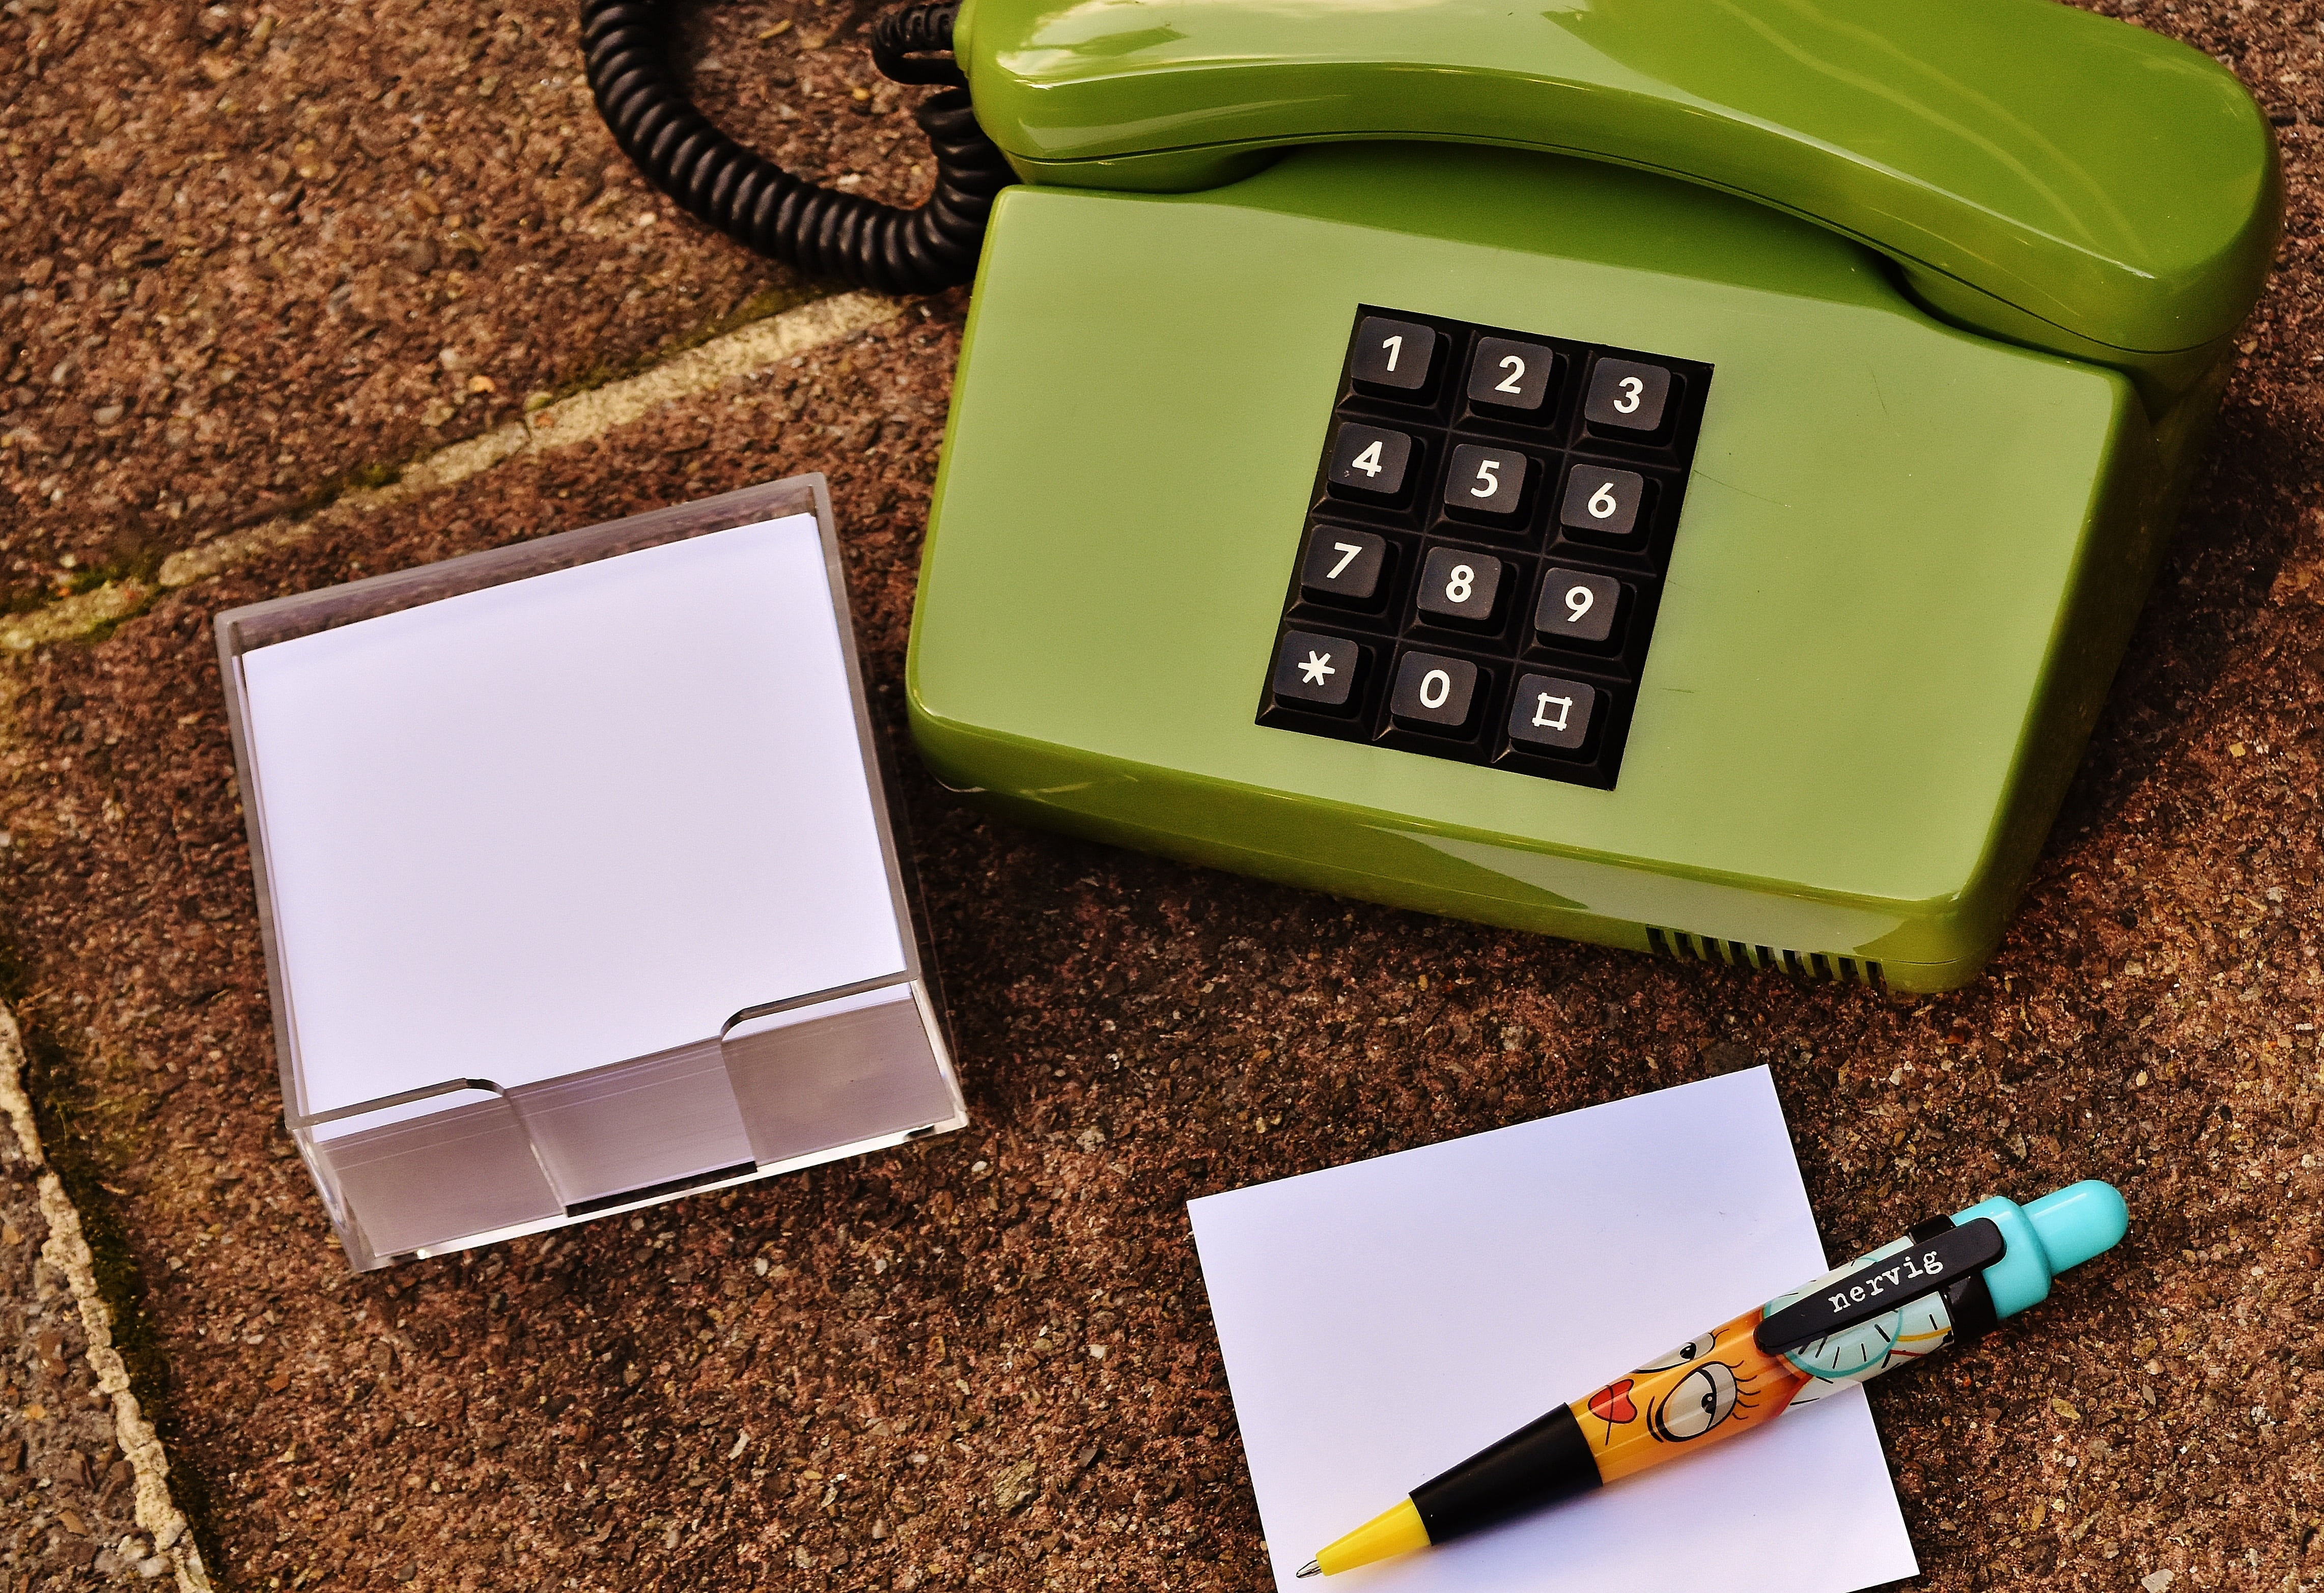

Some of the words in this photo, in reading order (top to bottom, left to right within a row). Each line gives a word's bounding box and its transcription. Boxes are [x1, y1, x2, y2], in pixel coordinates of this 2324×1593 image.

[1382, 335, 1403, 372] 1
[1494, 355, 1526, 395] 2
[1613, 376, 1644, 414] 3
[1351, 440, 1383, 478] 4
[1470, 459, 1500, 498] 5
[1587, 482, 1617, 519] 6
[1326, 541, 1363, 579] 7
[1445, 564, 1475, 603] 8
[1564, 585, 1594, 623] 9
[1419, 669, 1451, 709] 0
[1827, 1250, 1944, 1313] nervig
